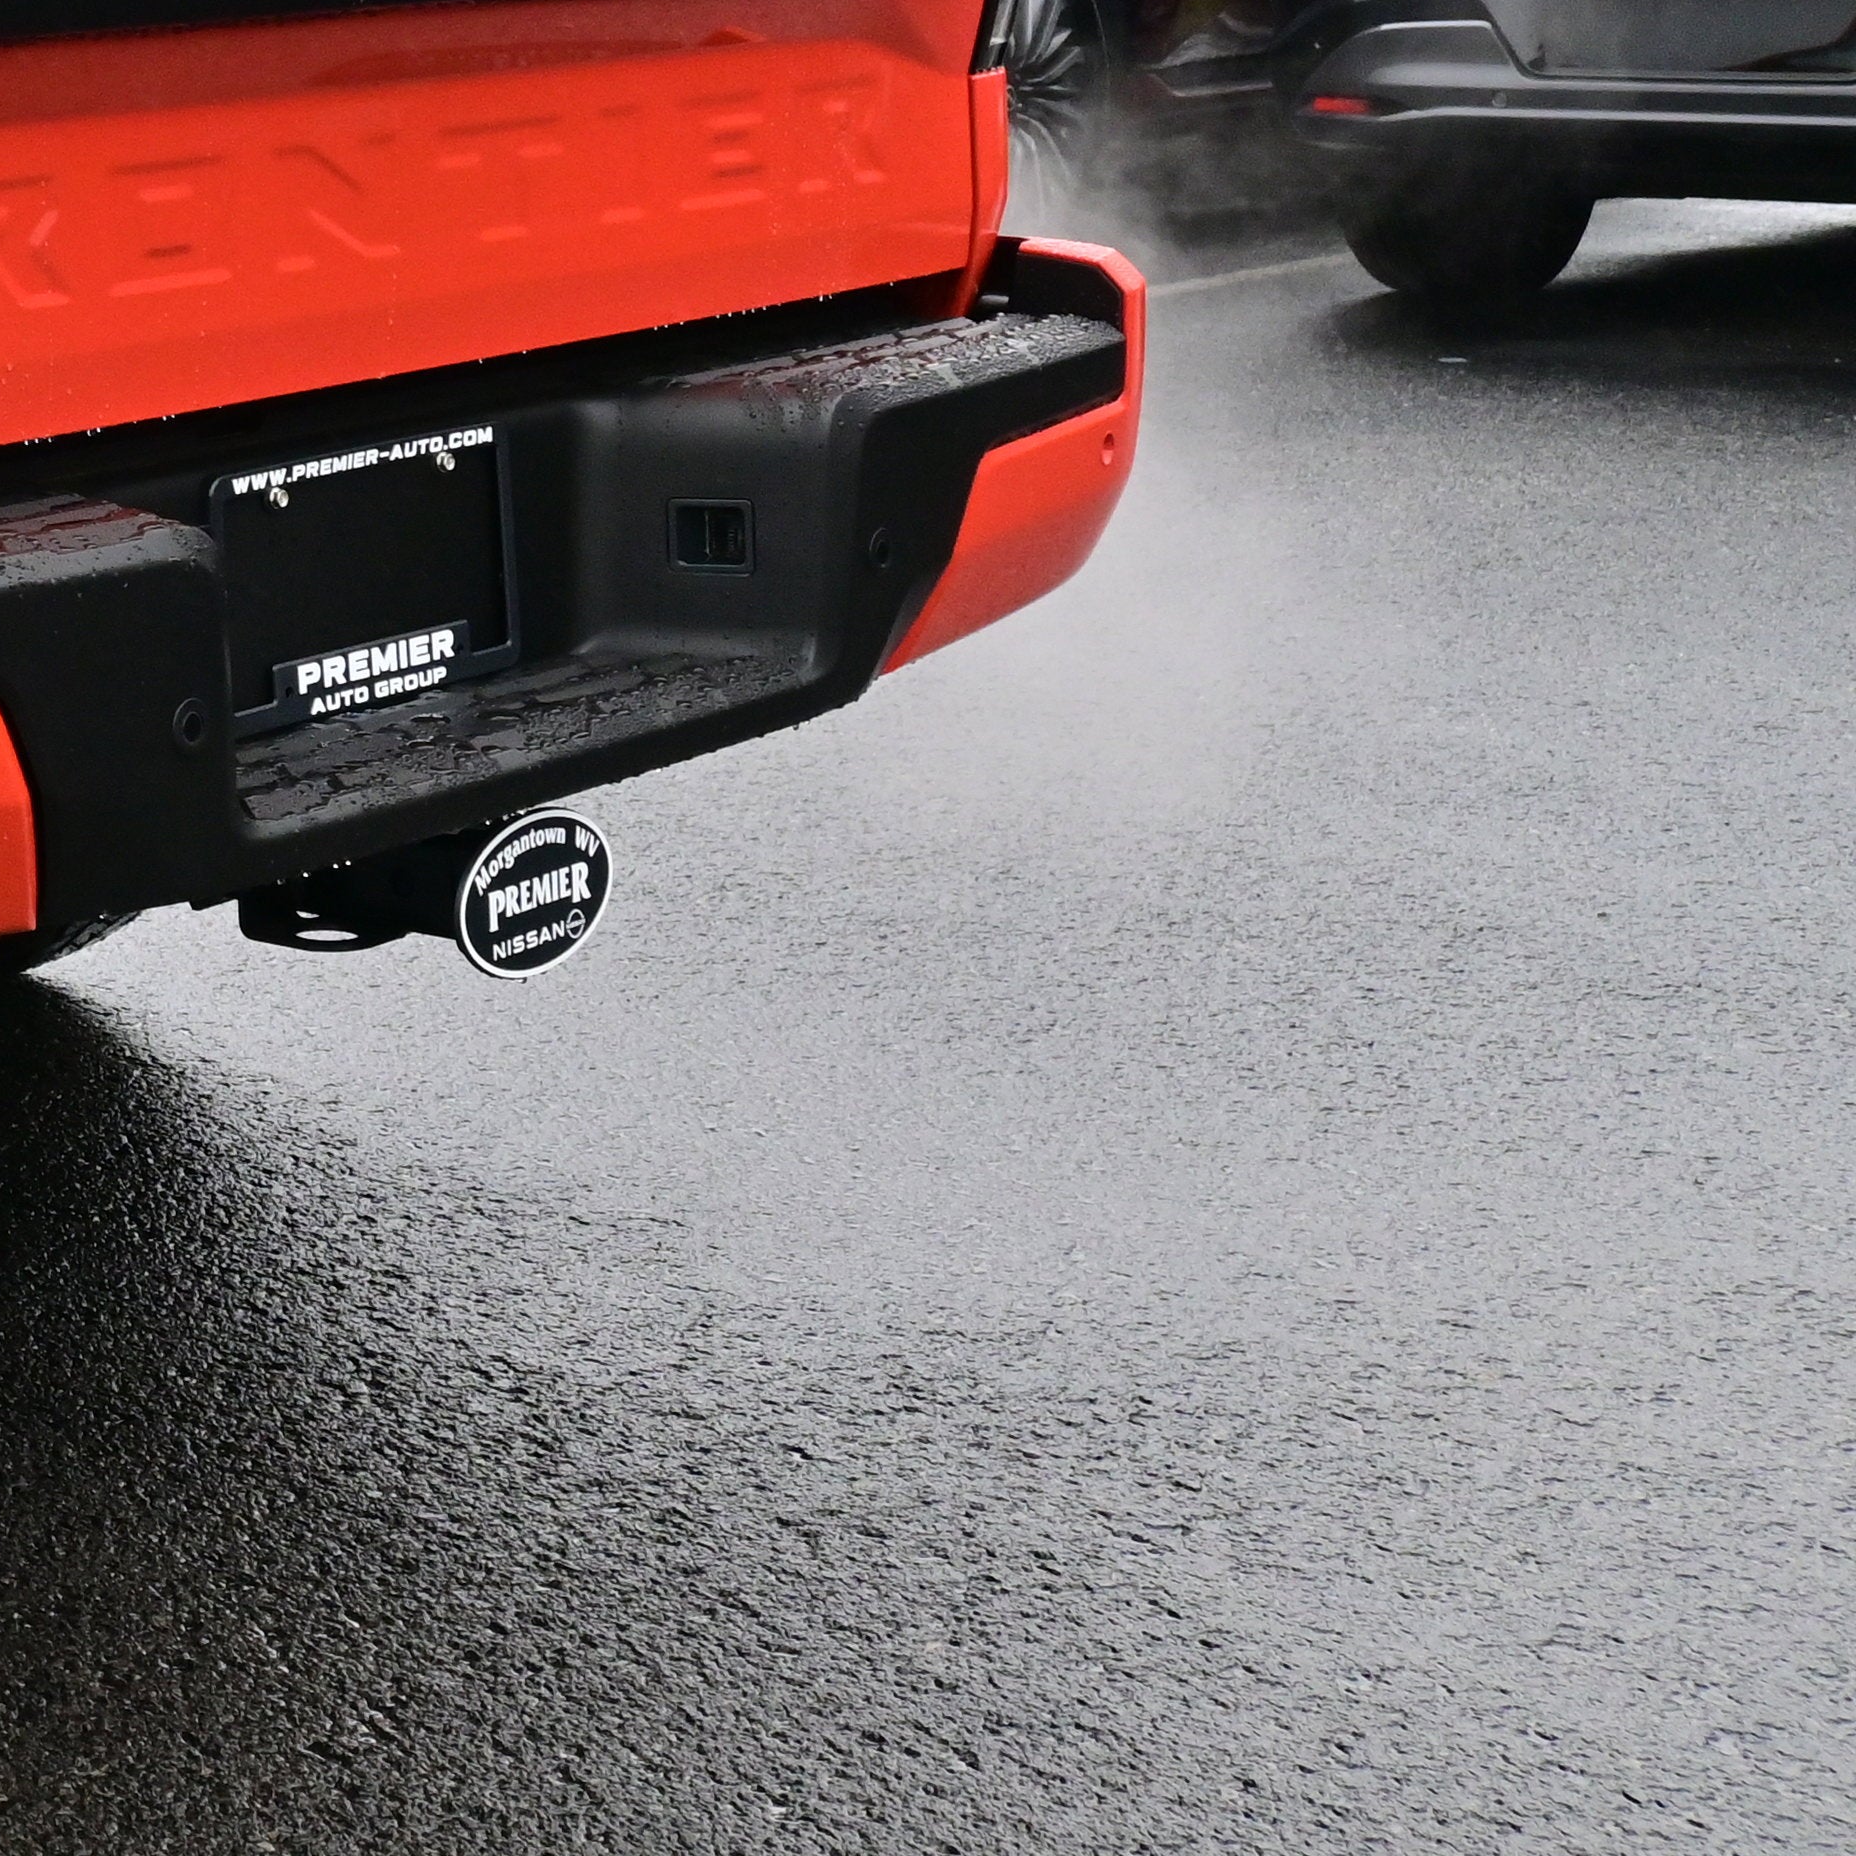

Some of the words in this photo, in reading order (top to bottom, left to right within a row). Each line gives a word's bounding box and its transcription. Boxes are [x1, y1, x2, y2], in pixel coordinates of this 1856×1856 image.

[232, 426, 493, 495] WWW.PREMIER-AUTO.COM
[297, 629, 455, 695] PREMIER
[310, 685, 369, 715] AUTO
[374, 666, 447, 699] GROUP
[474, 826, 566, 897] Morgantown
[574, 825, 601, 858] WV
[488, 861, 591, 933] PREMIER
[492, 920, 566, 961] NISSAN
